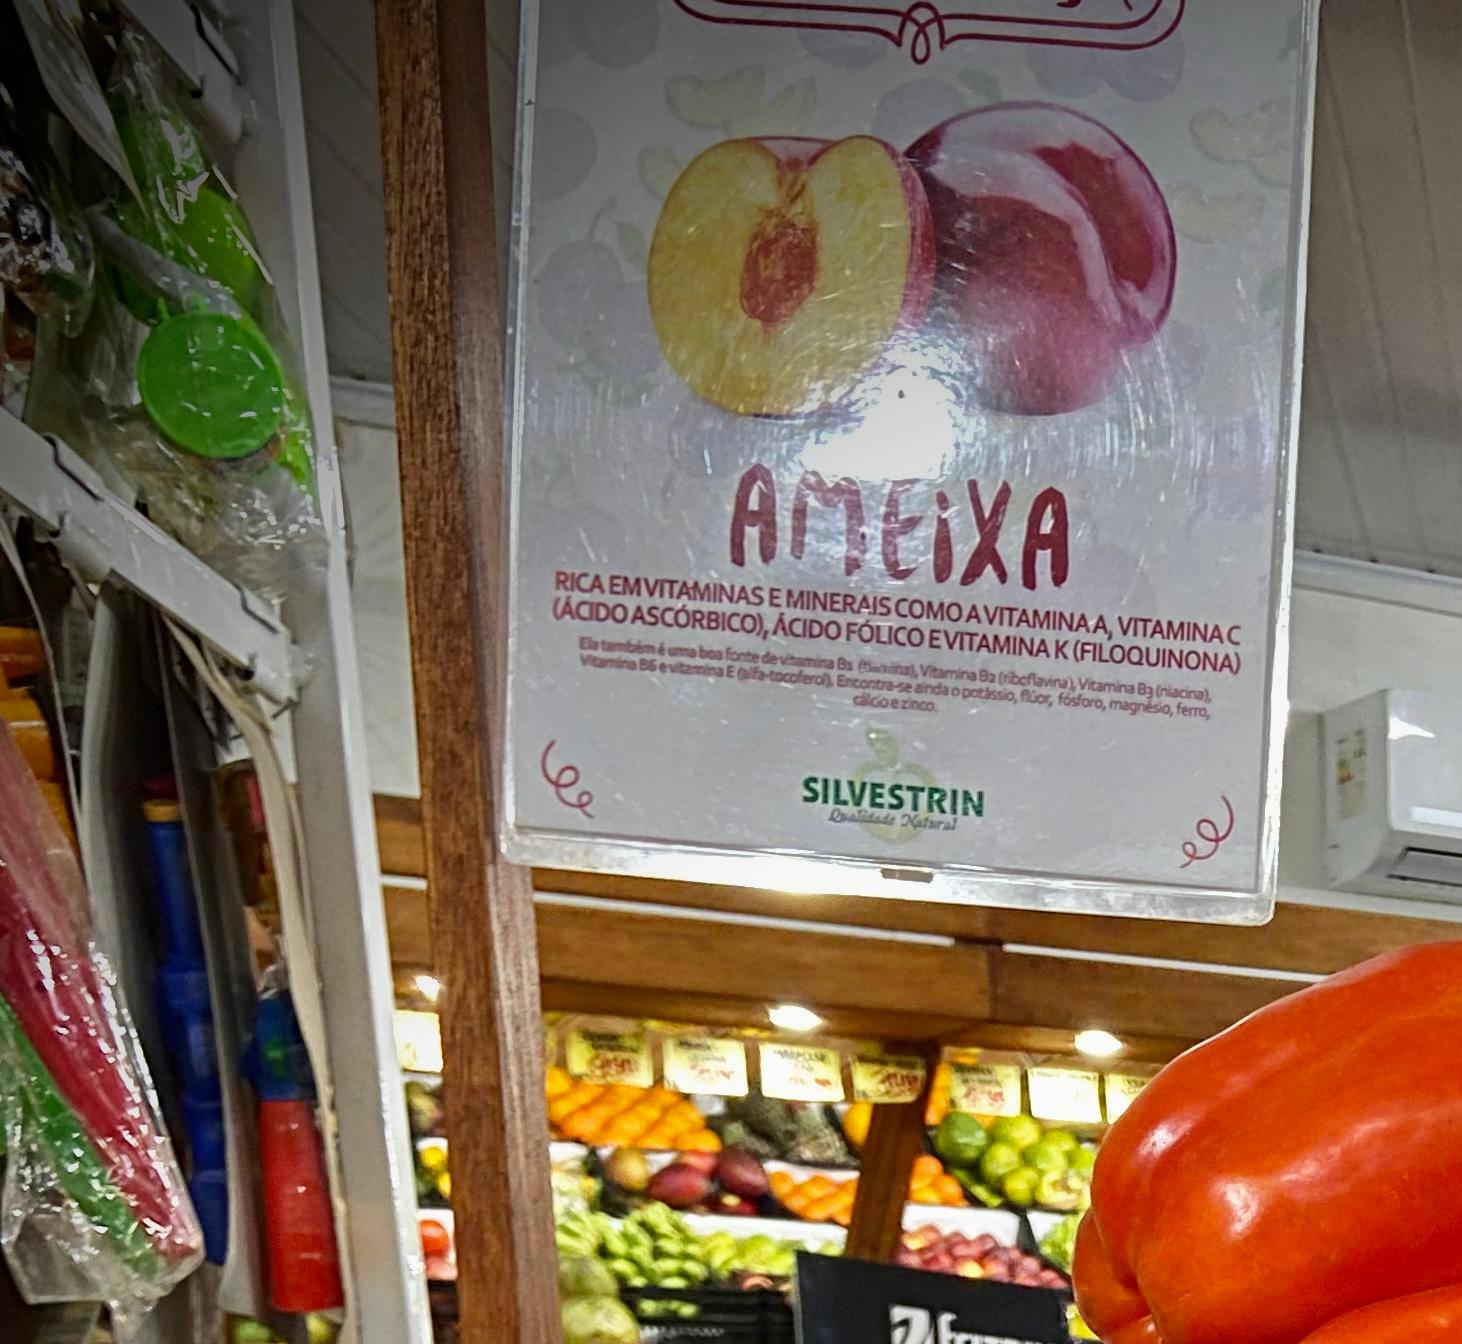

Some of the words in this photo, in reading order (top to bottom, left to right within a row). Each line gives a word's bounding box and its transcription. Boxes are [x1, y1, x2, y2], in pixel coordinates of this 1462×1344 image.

[553, 596, 627, 625] (ÁCIDO
[630, 602, 768, 640] ASCÓRBICO),
[771, 613, 842, 640] ÁCIDO
[846, 619, 924, 648] FÓLICO
[928, 629, 941, 649] E
[943, 631, 1050, 658] VITAMINA
[1055, 639, 1069, 660] K
[1073, 638, 1241, 675] (FILOQUINONA)
[555, 571, 605, 594] RICA
[609, 575, 640, 597] EM
[642, 578, 764, 607] VITAMINAS
[769, 587, 782, 607] E
[786, 589, 890, 616] MINERAIS
[895, 598, 962, 622] COMO
[966, 604, 981, 623] A
[982, 605, 1087, 633] VITAMINA
[1088, 615, 1113, 641] A,
[1117, 616, 1224, 644] VITAMINA
[1227, 625, 1241, 646] C
[668, 646, 696, 658] uma
[699, 646, 723, 660] boa
[725, 647, 759, 664] fonte
[761, 650, 778, 664] de
[780, 652, 834, 669] vitamina
[920, 663, 976, 681] Vitamina
[979, 669, 995, 683] B2
[1078, 677, 1135, 695] Vitamina
[1156, 683, 1212, 703] (niacina),
[726, 665, 735, 677] E
[836, 674, 913, 692] Encontra-se
[915, 681, 949, 696] ainda
[951, 686, 960, 697] o
[1058, 692, 1106, 711] fósforo,
[1109, 699, 1173, 718] magnésio,
[1176, 702, 1210, 720] ferro,
[802, 776, 985, 817] SILVESTRIN
